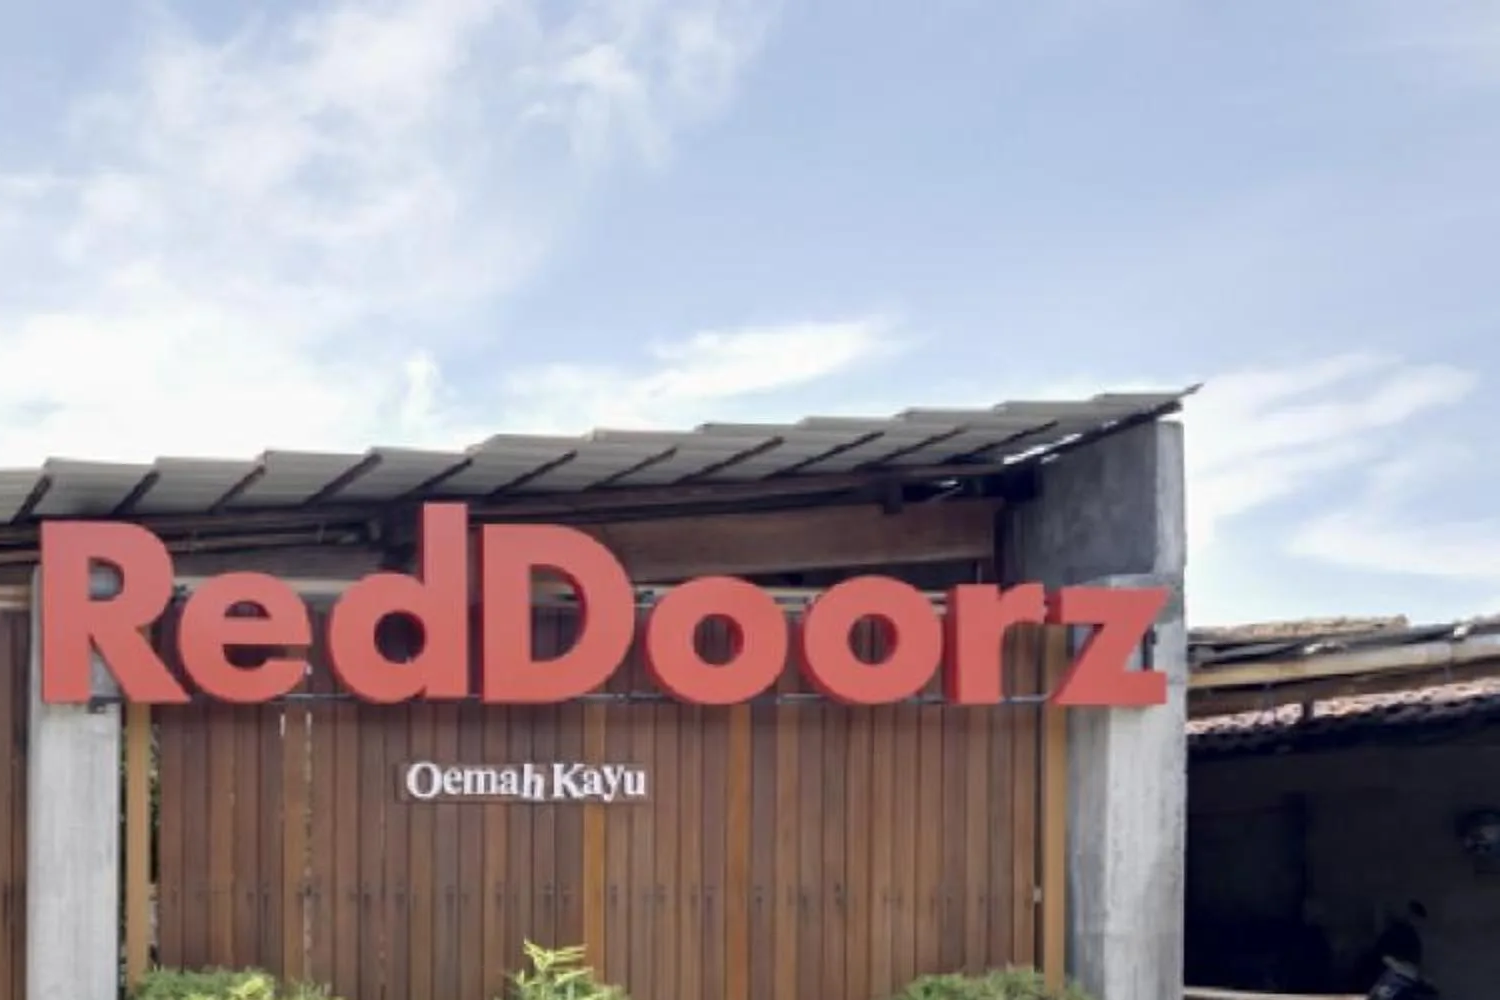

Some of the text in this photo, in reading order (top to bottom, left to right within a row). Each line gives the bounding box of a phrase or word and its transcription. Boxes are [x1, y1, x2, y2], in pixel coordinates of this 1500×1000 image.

[40, 502, 1167, 707] RedDoorz
[406, 761, 645, 802] Oemah Kayu
